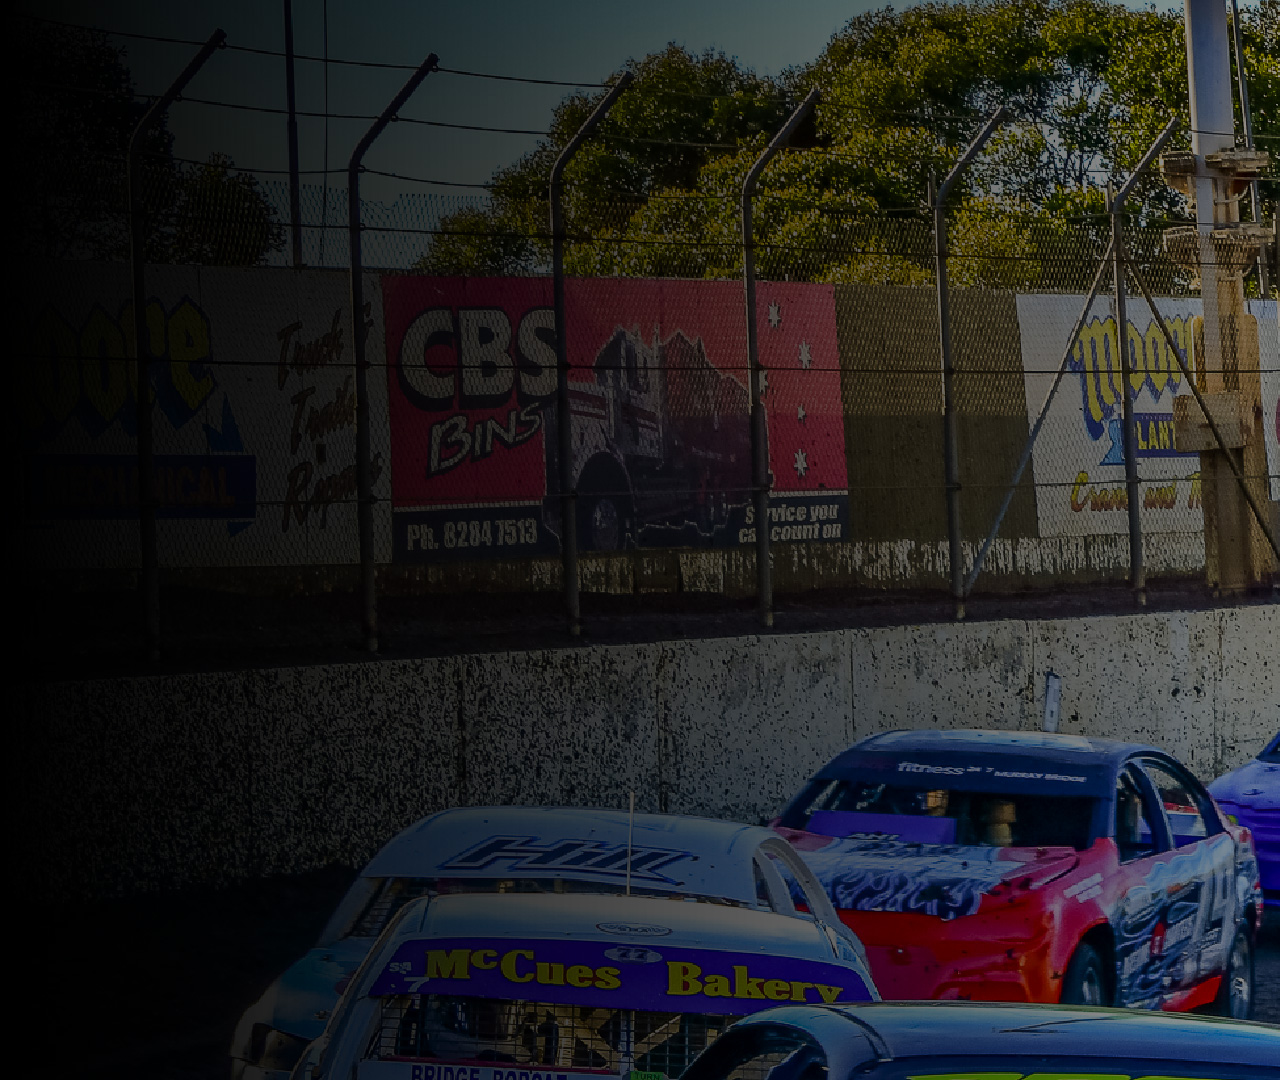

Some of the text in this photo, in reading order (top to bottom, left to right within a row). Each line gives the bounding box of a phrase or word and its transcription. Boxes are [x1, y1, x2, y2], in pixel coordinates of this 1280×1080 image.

[14, 297, 215, 428] oore
[398, 307, 558, 408] CBS
[1068, 314, 1194, 440] Moor
[407, 517, 538, 550] Ph. 8284 7513
[745, 504, 839, 524] Srvice you
[769, 522, 820, 541] count
[822, 523, 842, 539] on
[423, 949, 844, 1003] McCues Bakery
